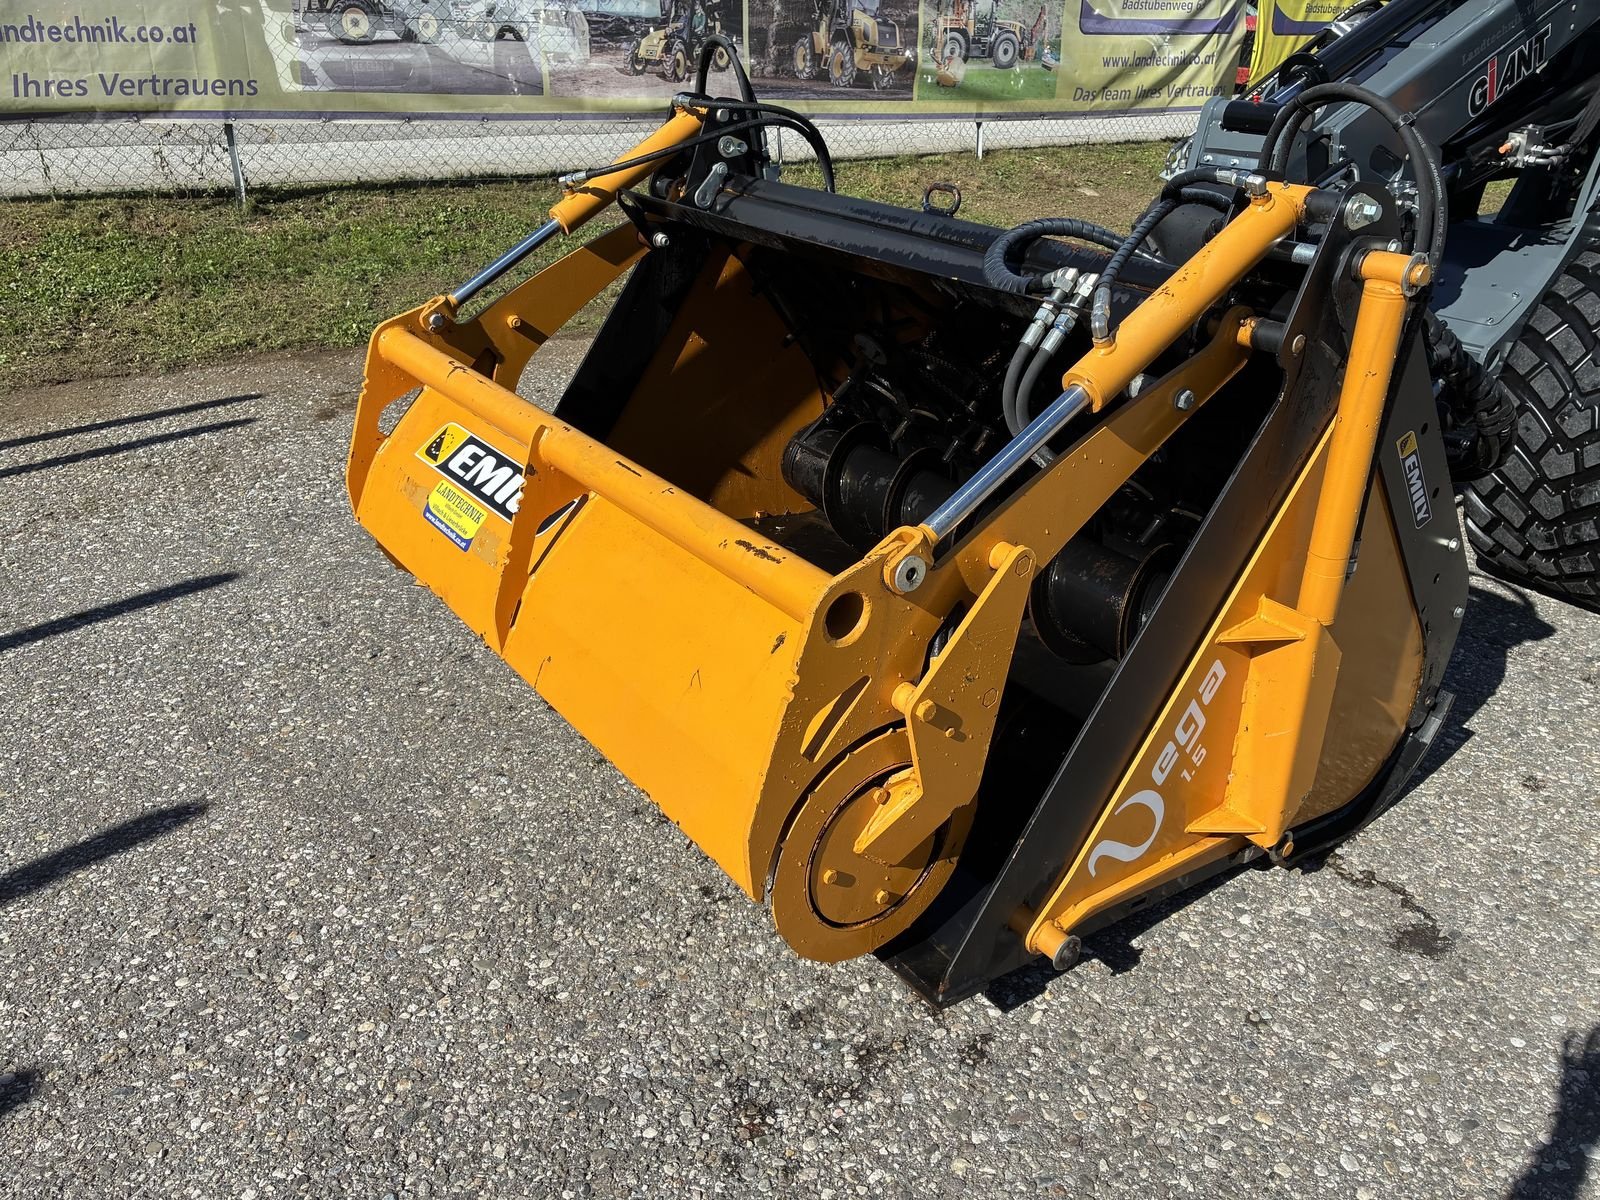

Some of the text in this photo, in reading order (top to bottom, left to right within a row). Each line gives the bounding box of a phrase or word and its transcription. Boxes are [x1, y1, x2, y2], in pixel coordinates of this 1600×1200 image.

[1122, 0, 1193, 13] Badstubenweg
[13, 73, 258, 97] Ihres Vertrauens
[1073, 87, 1096, 102] Das
[1101, 87, 1131, 100] Team
[436, 482, 484, 525] LANDTECHNIK
[1405, 454, 1429, 521] EMILY
[1180, 743, 1207, 783] 1.5
